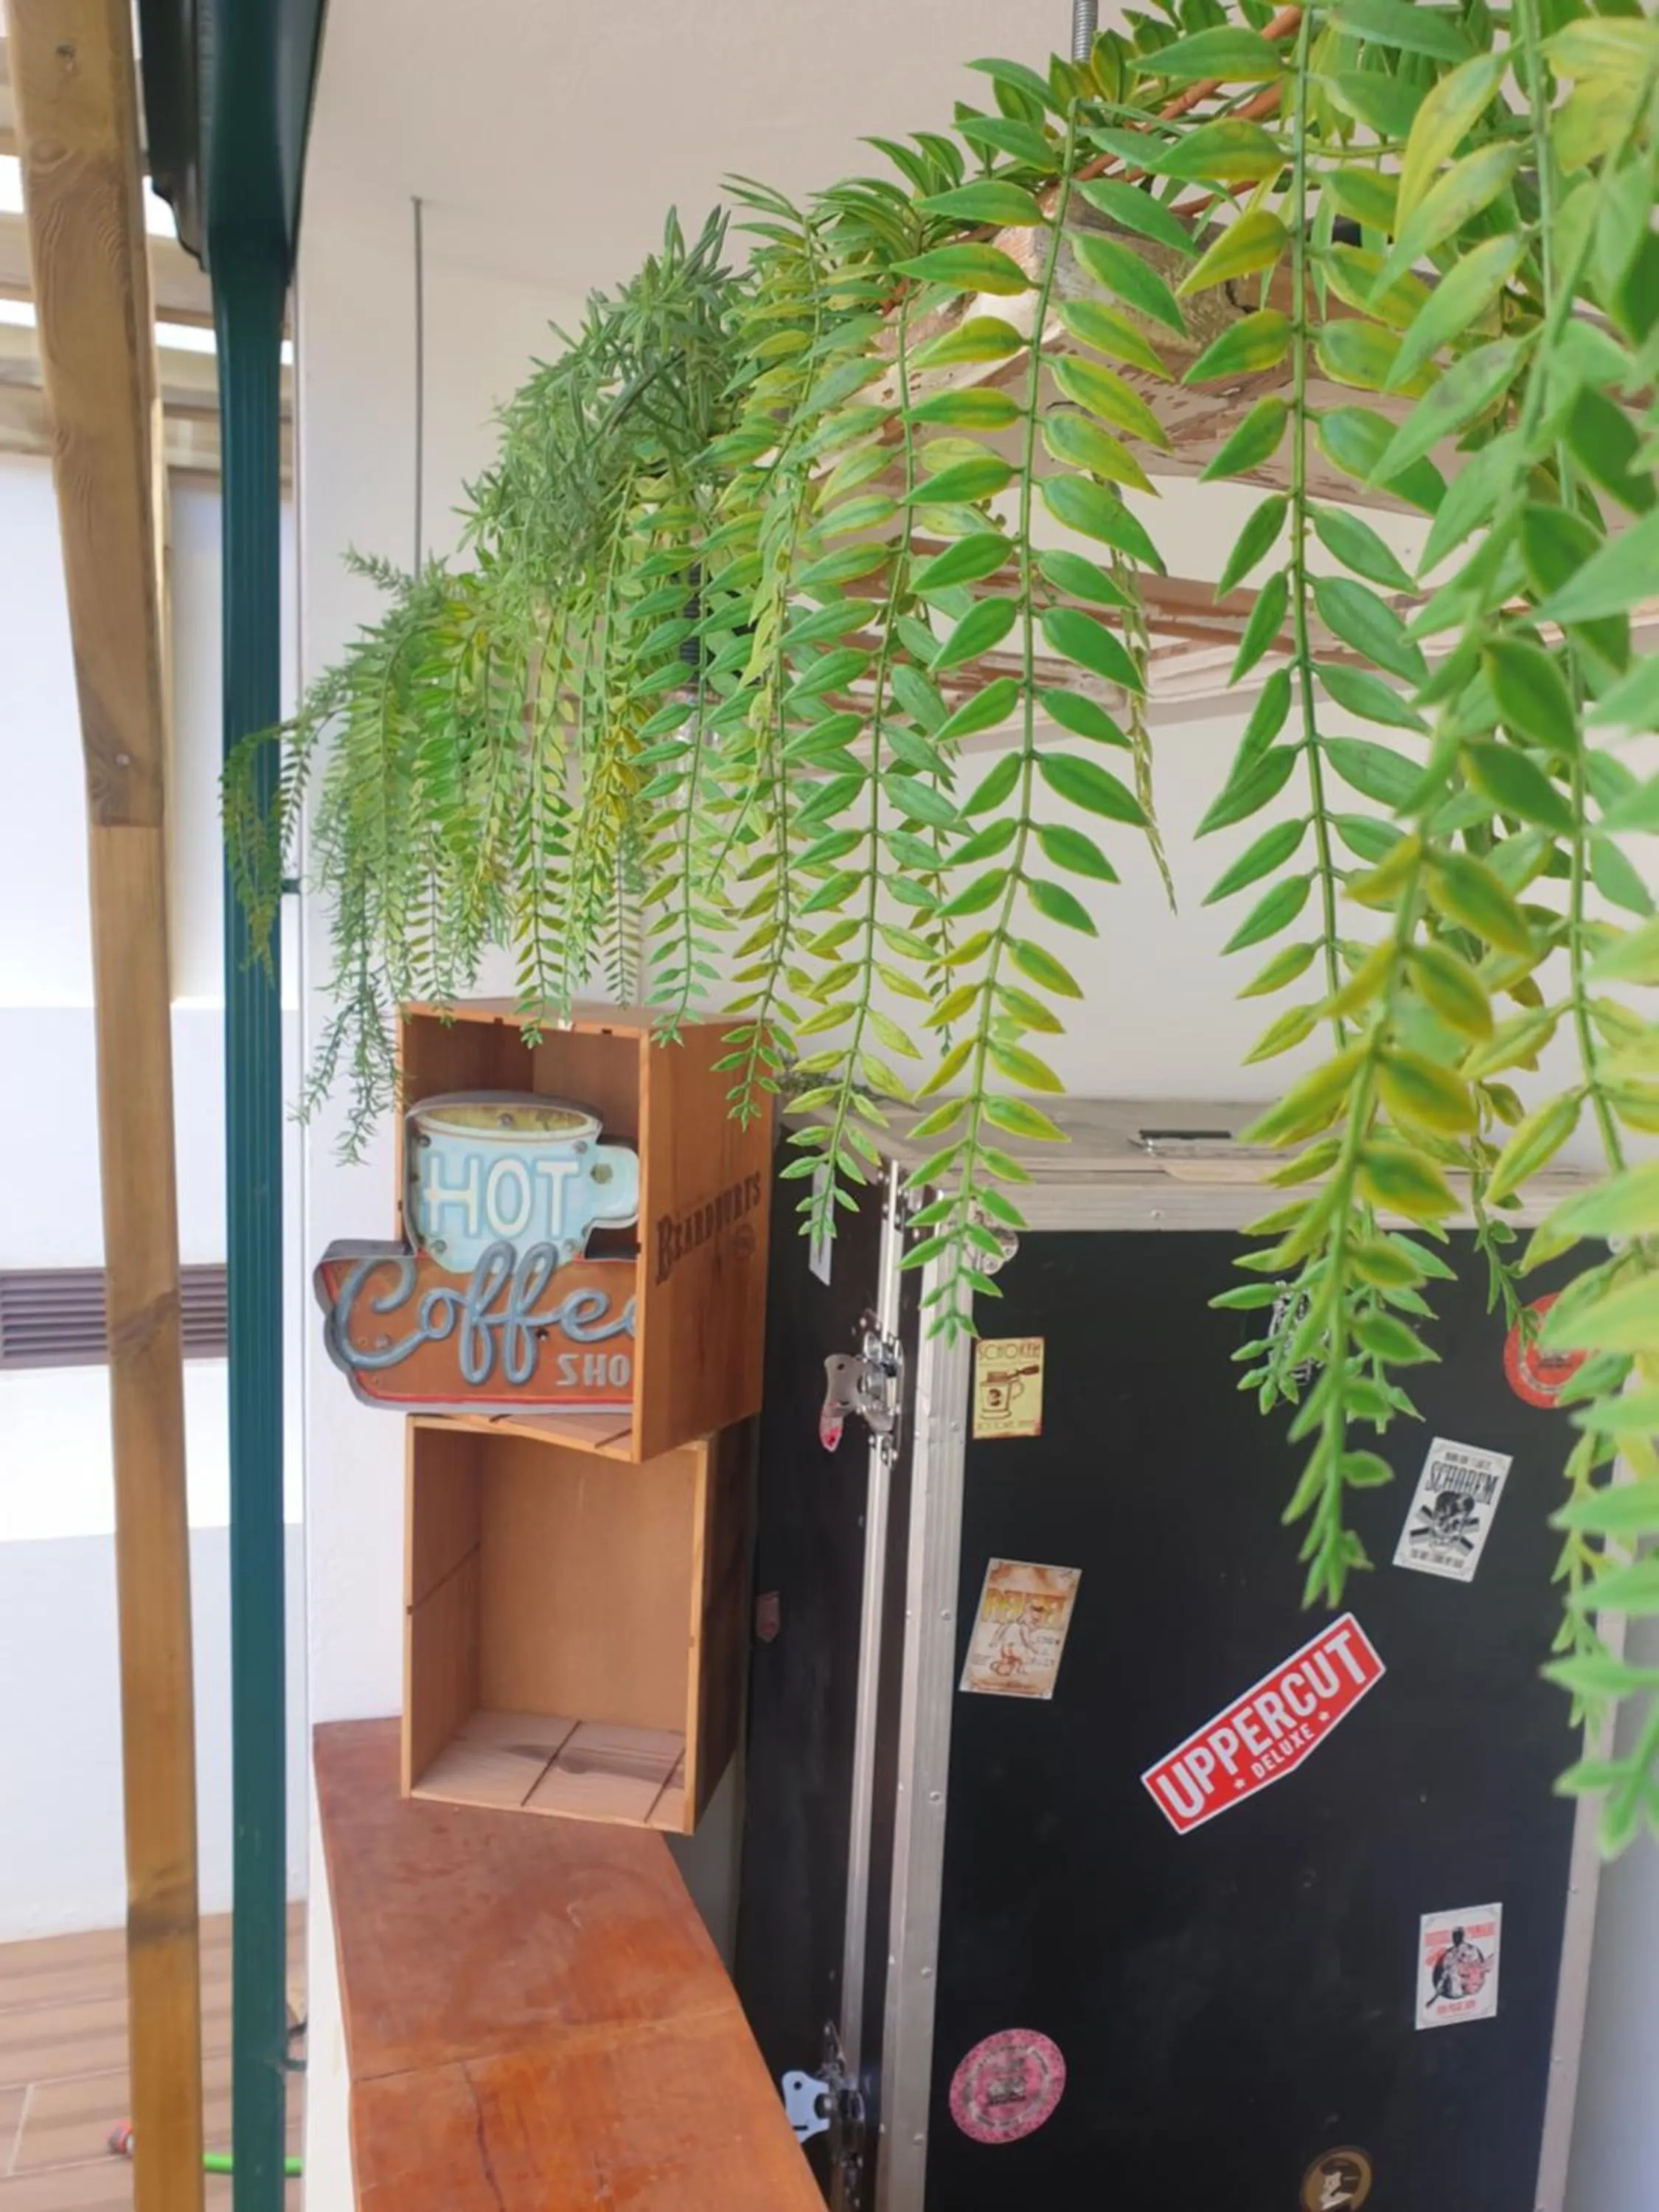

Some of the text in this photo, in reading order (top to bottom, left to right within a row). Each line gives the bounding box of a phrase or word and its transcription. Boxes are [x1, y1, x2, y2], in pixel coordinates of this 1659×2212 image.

[424, 1153, 581, 1238] HOT
[1155, 1630, 1366, 1818] UPPERCUT
[1250, 1722, 1315, 1779] DELUXE
